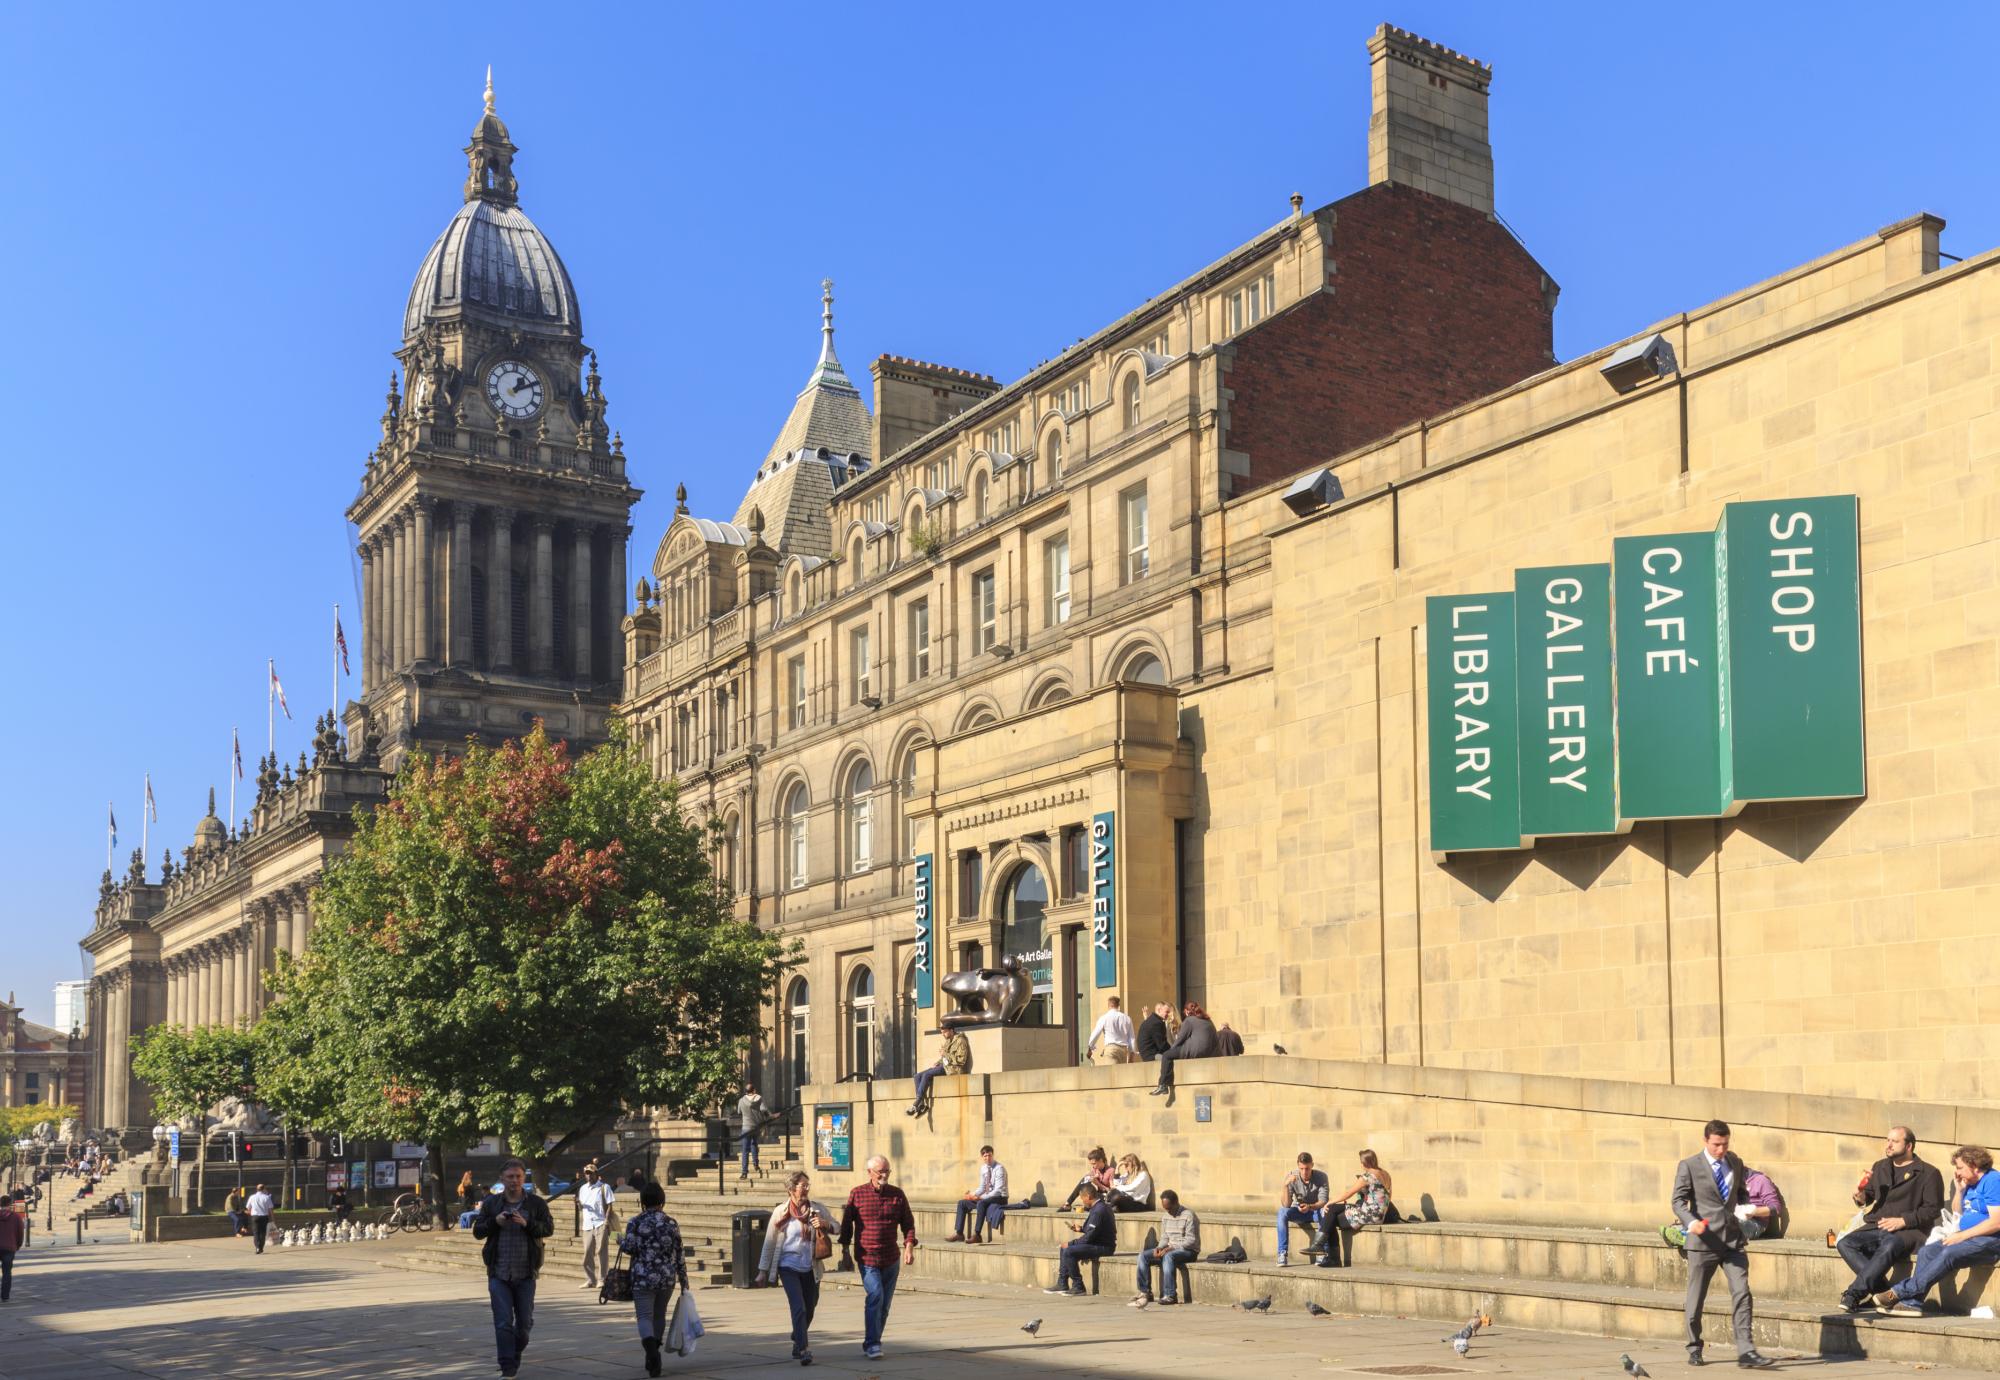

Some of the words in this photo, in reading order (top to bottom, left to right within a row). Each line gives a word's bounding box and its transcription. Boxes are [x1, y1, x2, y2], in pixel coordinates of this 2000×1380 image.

[1642, 547, 1699, 676] CAFÉ
[1769, 511, 1815, 653] SHOP
[1452, 605, 1491, 801] LIBRARY
[1545, 577, 1587, 792] GALLERY
[915, 860, 928, 974] LIBRARY
[1093, 820, 1110, 951] GALLERY
[1024, 951, 1035, 962] Art
